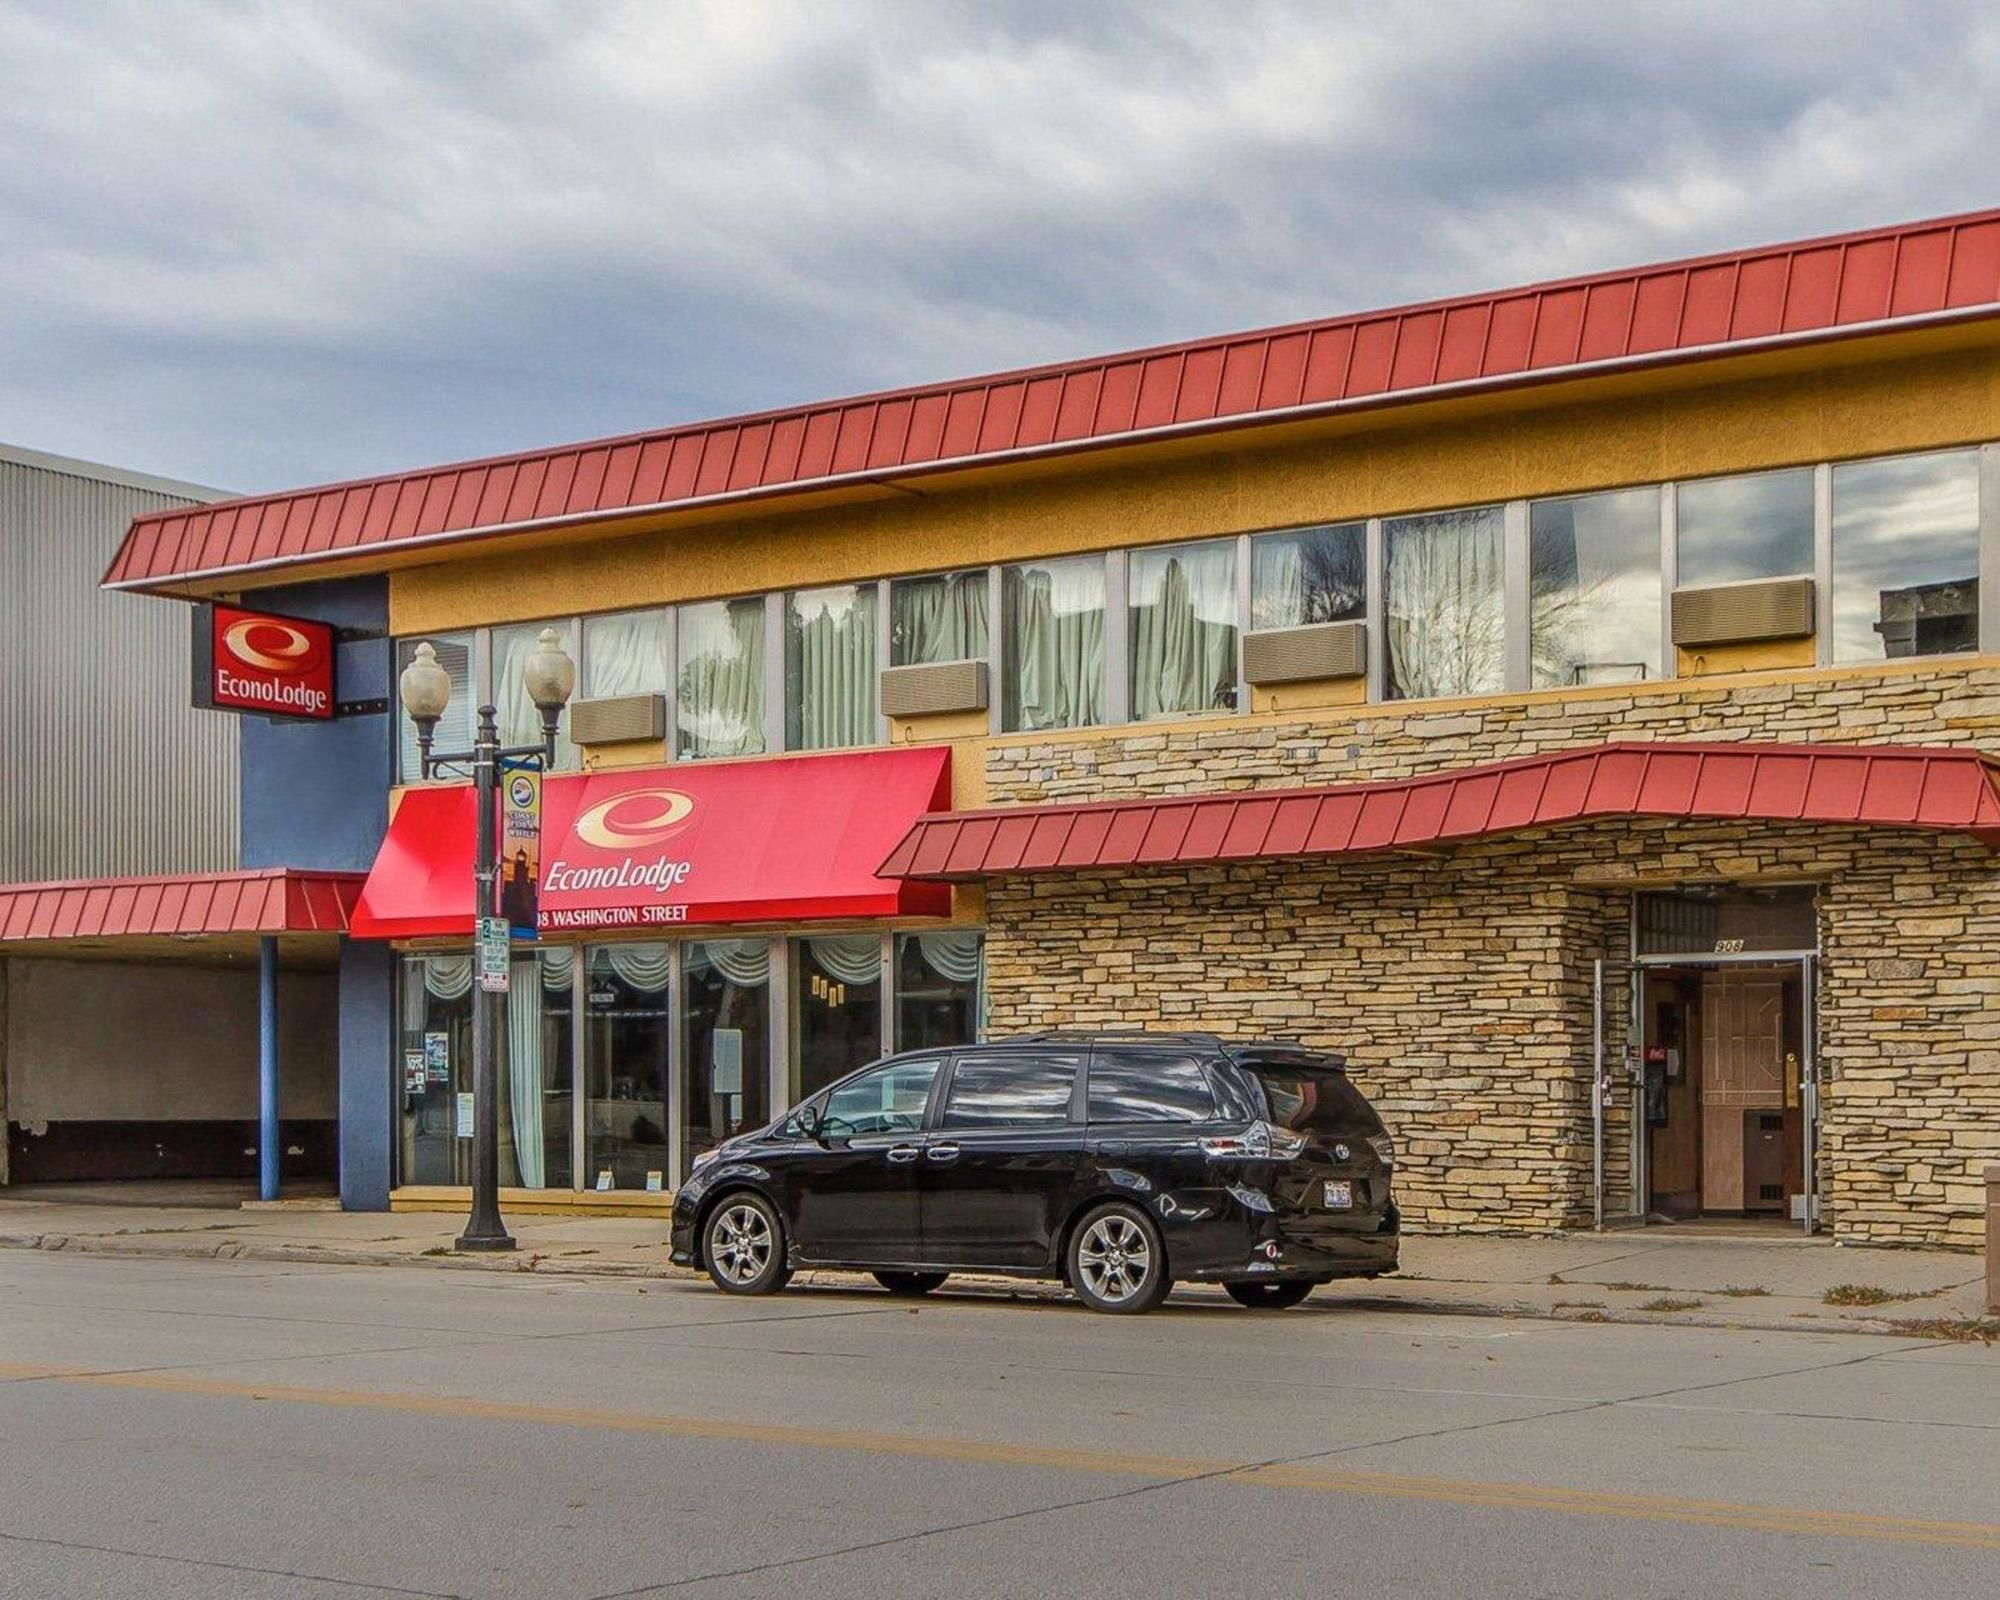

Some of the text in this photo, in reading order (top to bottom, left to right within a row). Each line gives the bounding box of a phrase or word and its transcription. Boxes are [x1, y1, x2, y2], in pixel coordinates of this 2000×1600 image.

[217, 669, 327, 712] EconoLodge
[544, 856, 691, 893] EconoLodge
[552, 907, 638, 927] WASHINGTON
[642, 905, 689, 922] STREET
